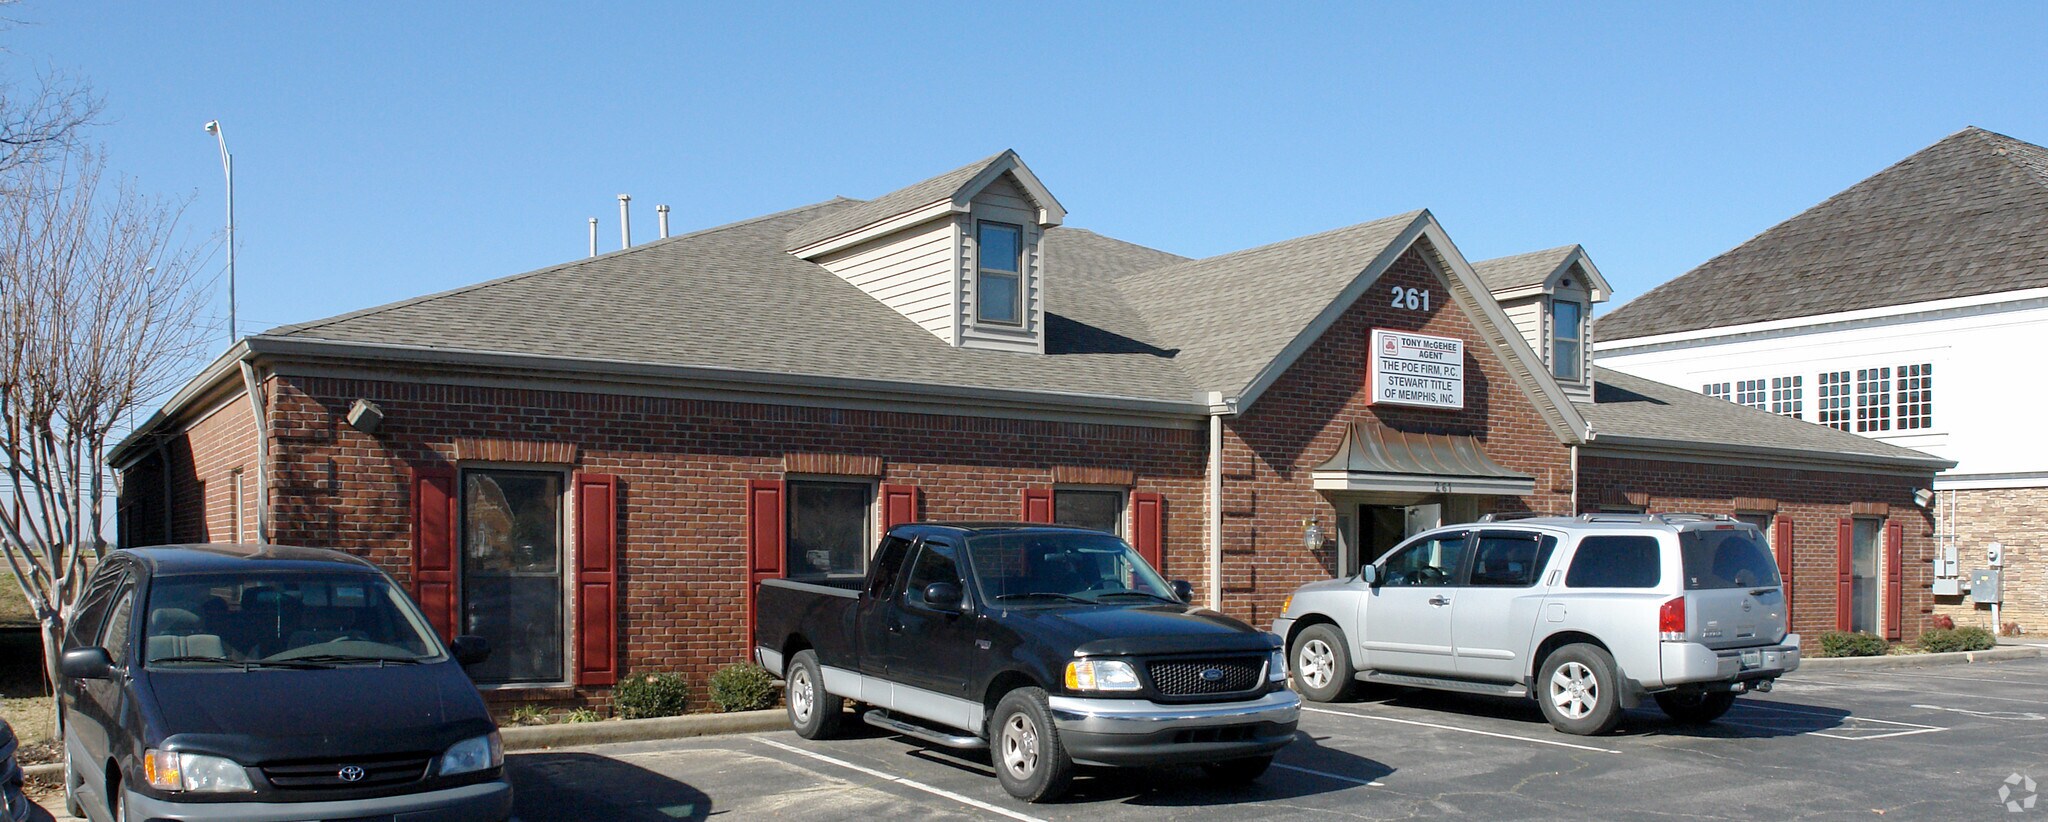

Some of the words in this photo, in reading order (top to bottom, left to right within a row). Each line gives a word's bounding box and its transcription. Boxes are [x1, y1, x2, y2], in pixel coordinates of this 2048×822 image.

[1391, 286, 1429, 311] 261
[1401, 337, 1421, 347] TONY
[1423, 340, 1457, 351] McGEHEE
[1419, 350, 1443, 360] AGENT
[1383, 360, 1399, 371] THE
[1401, 362, 1419, 373] POE
[1420, 364, 1443, 376] FIRM,
[1444, 366, 1458, 377] P.C.
[1388, 376, 1429, 388] STEWART
[1430, 379, 1453, 391] TITLE
[1384, 388, 1397, 398] OF
[1398, 389, 1438, 403] MEMPHIS,
[1440, 393, 1456, 404] INC.
[1434, 481, 1452, 493] 261
